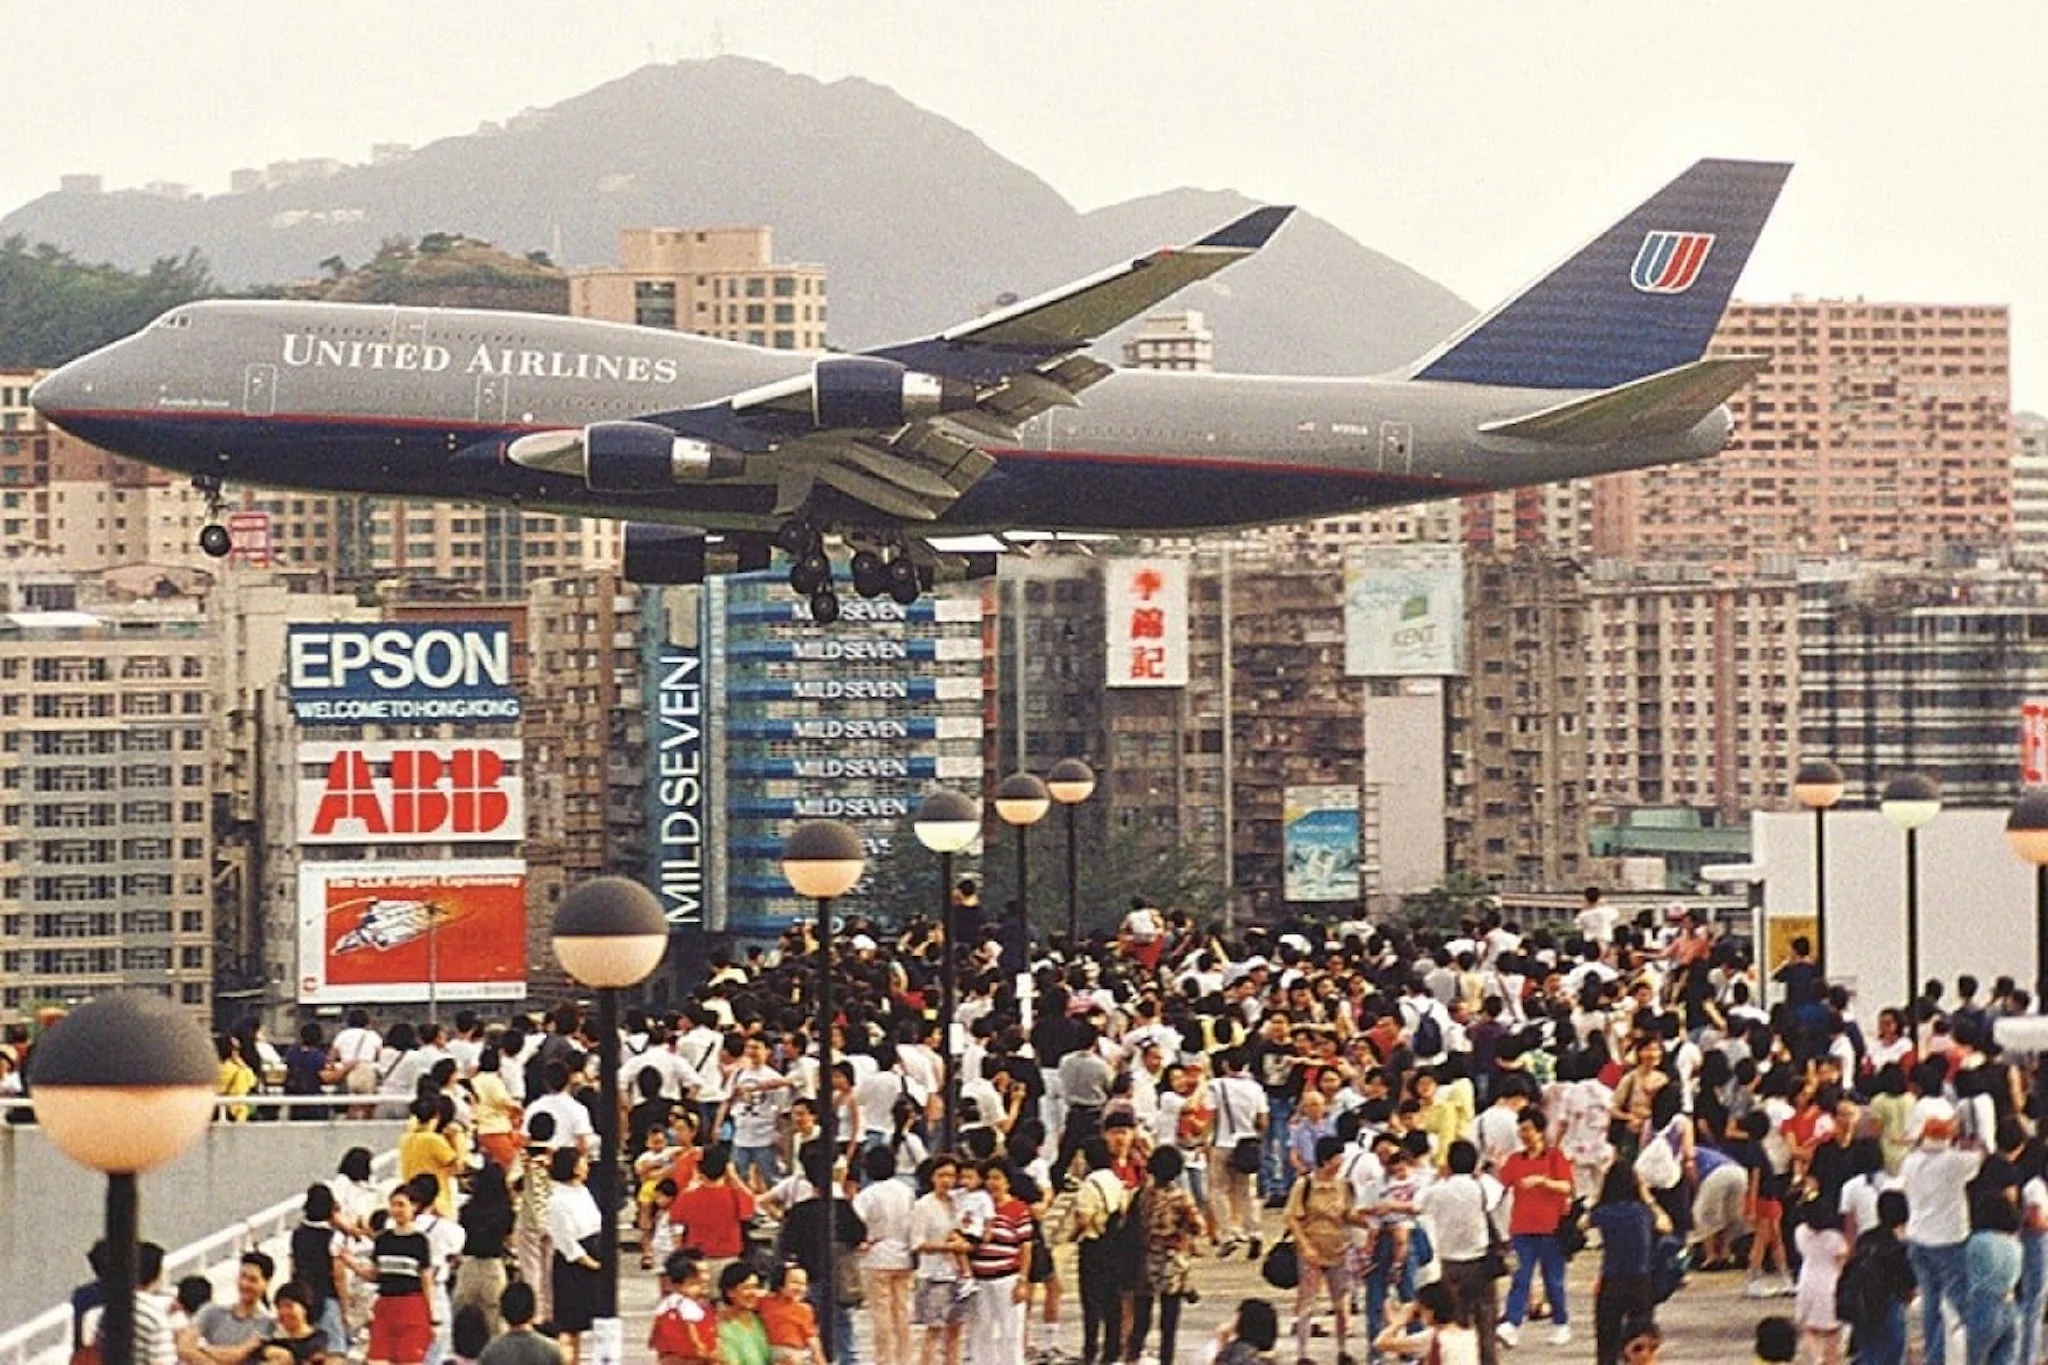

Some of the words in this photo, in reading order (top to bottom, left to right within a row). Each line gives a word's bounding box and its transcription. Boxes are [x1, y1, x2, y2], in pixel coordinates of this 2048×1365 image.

[281, 333, 451, 373] UNITED
[465, 343, 678, 384] AIRLINES
[289, 630, 509, 689] EPSON
[792, 641, 841, 659] MILD
[843, 641, 908, 660] SEVEN
[792, 682, 841, 699] MILD
[843, 682, 908, 699] SEVEN
[295, 701, 390, 717] WELCOME
[391, 701, 412, 717] TO
[415, 700, 466, 717] HONG
[467, 699, 520, 716] KONG
[660, 656, 700, 806] SEVEN
[792, 721, 842, 738] MILD
[844, 721, 908, 738] SEVEN
[793, 760, 842, 777] MILD
[844, 760, 908, 777] SEVEN
[311, 748, 509, 834] ABB
[793, 799, 842, 816] MILD
[844, 799, 908, 816] SEVEN
[662, 811, 701, 923] MILD
